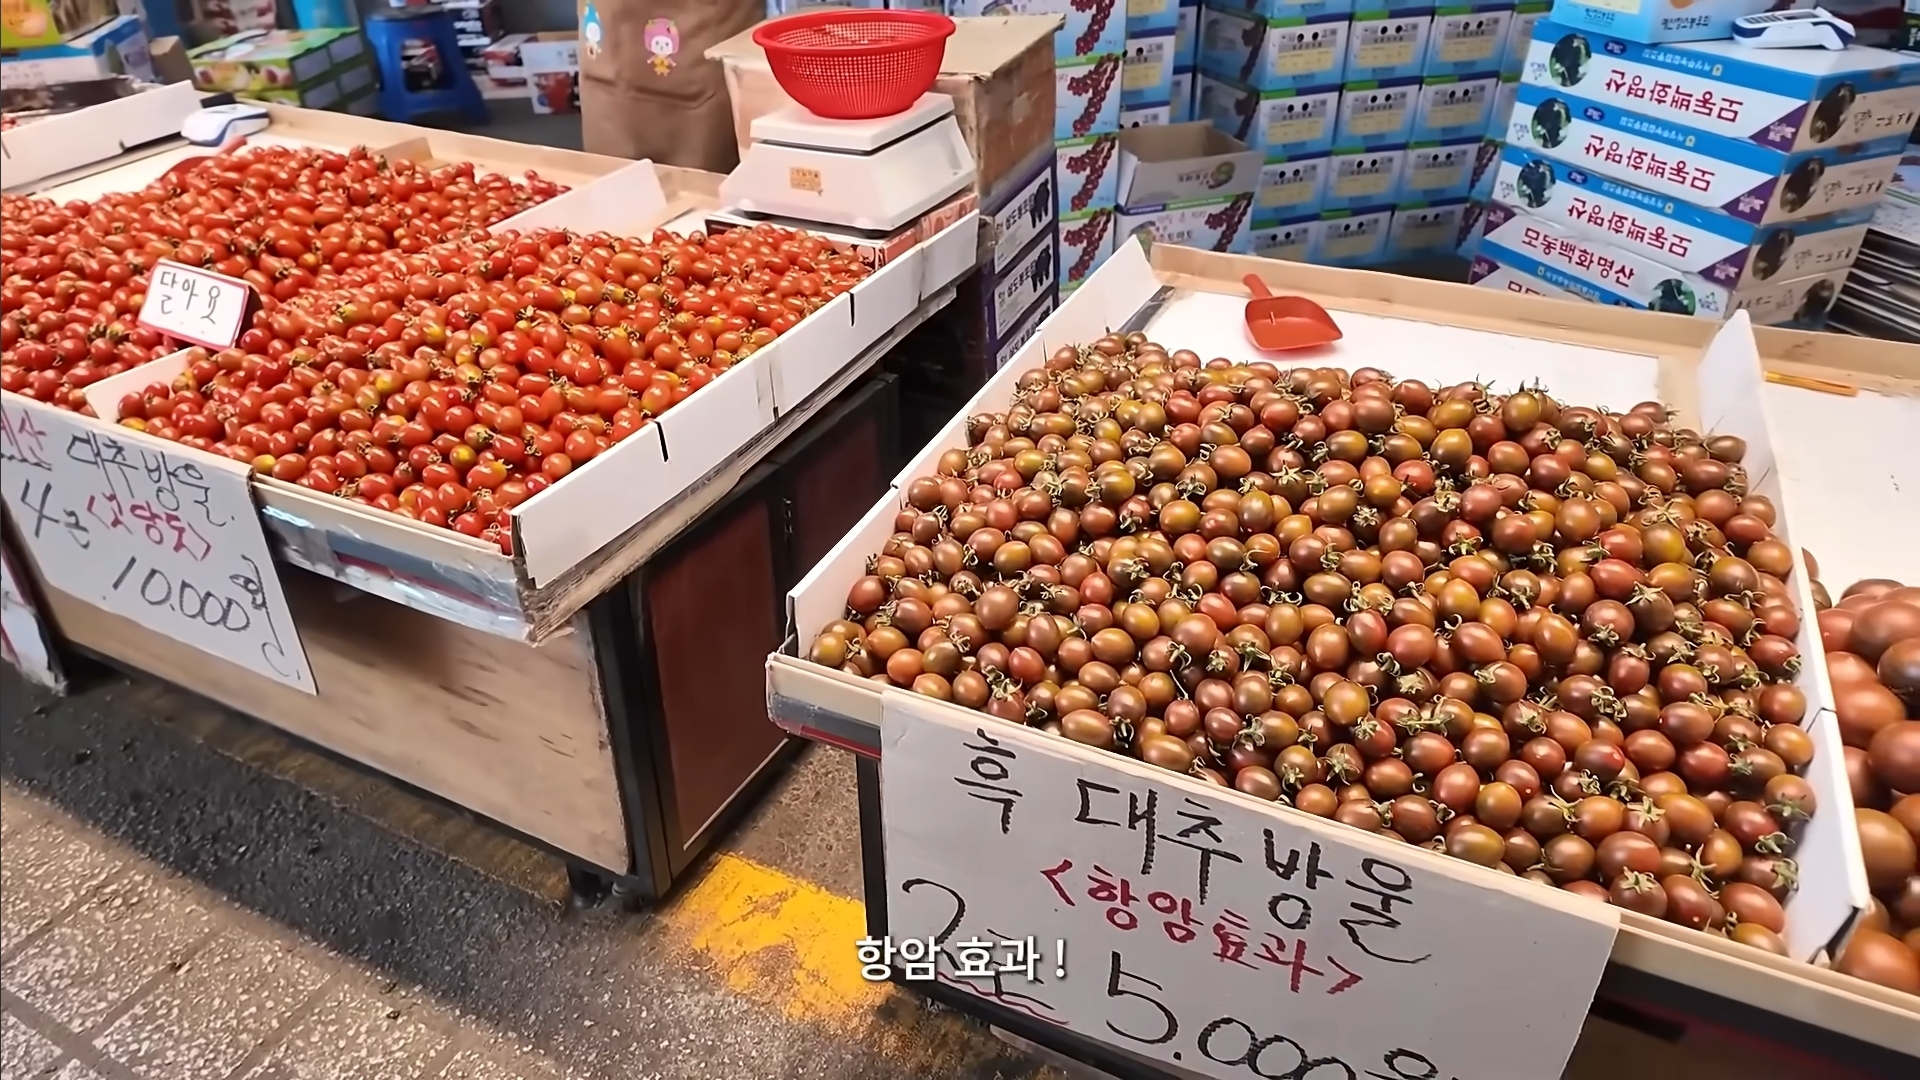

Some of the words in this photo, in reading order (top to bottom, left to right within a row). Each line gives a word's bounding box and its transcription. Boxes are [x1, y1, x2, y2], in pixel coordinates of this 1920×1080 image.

[158, 270, 222, 325] 달아요
[20, 478, 90, 550] 4근
[954, 728, 1023, 835] 흑
